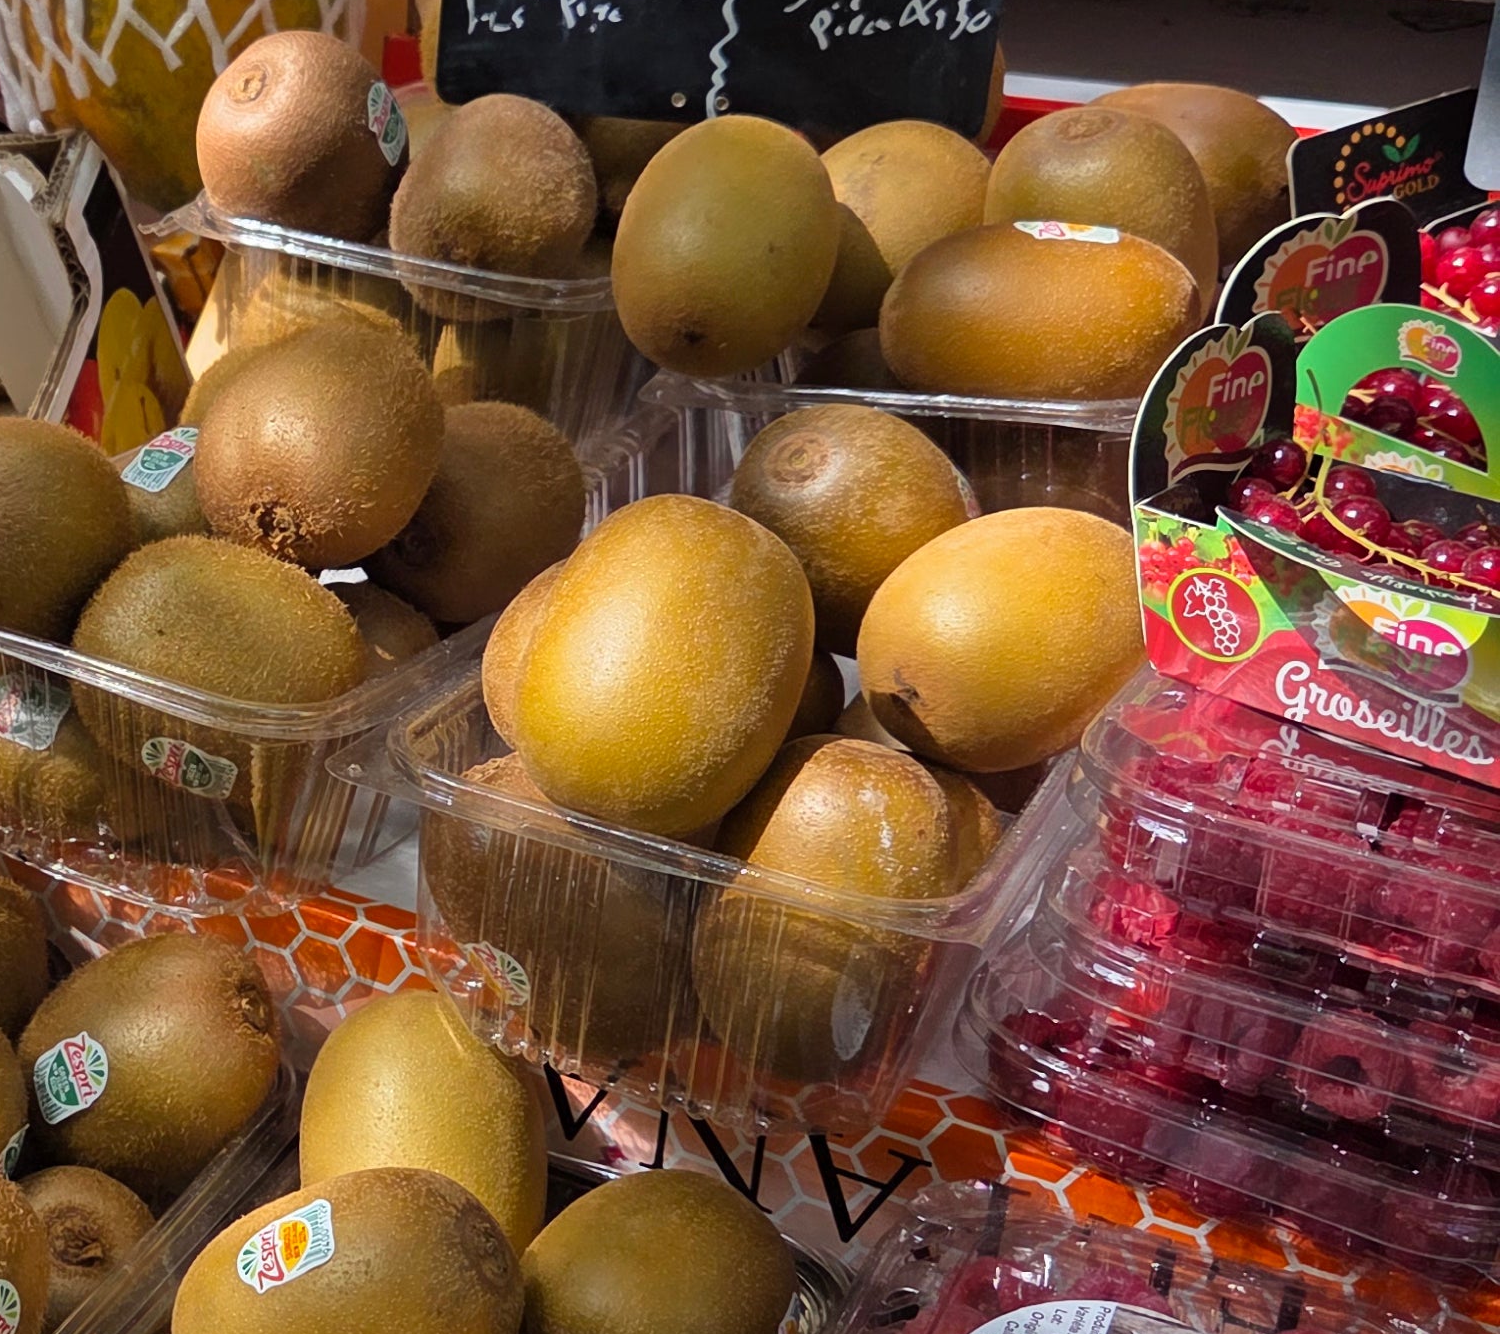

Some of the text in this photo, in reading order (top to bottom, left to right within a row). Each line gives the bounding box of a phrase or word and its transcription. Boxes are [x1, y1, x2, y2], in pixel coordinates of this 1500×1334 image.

[1392, 174, 1441, 200] GOLD
[1305, 249, 1380, 289] Fine
[1205, 369, 1265, 408] Fine
[1371, 615, 1463, 658] Fine
[1274, 659, 1496, 766] Groseilles
[63, 1033, 99, 1101] Zespri
[257, 1227, 285, 1291] Zespri
